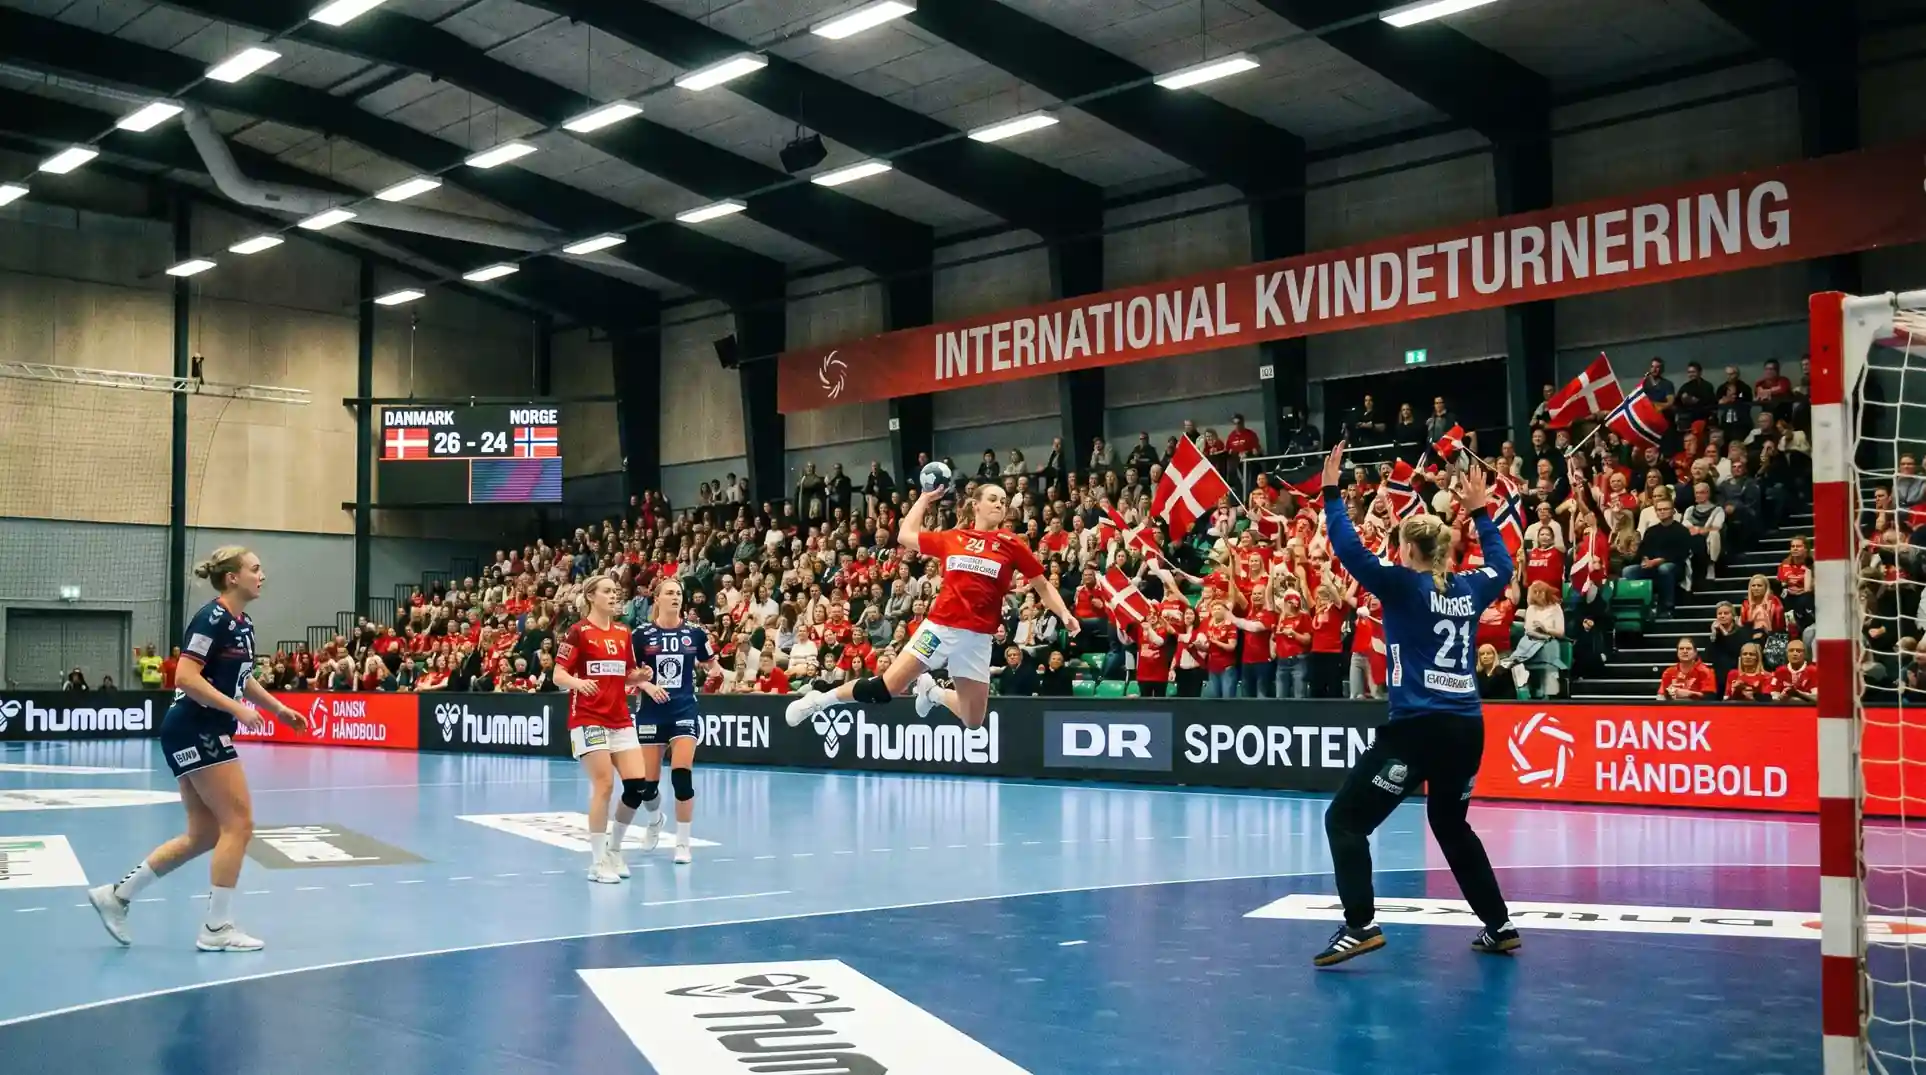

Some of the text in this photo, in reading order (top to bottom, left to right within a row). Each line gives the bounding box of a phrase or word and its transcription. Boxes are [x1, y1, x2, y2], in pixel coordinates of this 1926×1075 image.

[934, 180, 1792, 380] INTERNATIONAL KVINDETURNERING
[384, 410, 455, 426] DANMARK
[510, 409, 558, 425] NORGE
[433, 431, 461, 454] 26
[480, 431, 507, 453] 24
[604, 639, 618, 656] 15
[661, 636, 680, 653] 10
[1433, 619, 1470, 670] 21
[25, 699, 153, 732] hummel
[332, 700, 366, 718] DANSK
[462, 704, 550, 746] hummel
[332, 720, 386, 741] HÅNDBOLD
[856, 709, 999, 764] hummel
[1062, 723, 1153, 758] DR
[1184, 724, 1376, 769] SPORTEN
[1595, 720, 1711, 752] DANSK
[1595, 755, 1788, 797] HÅNDBOLD
